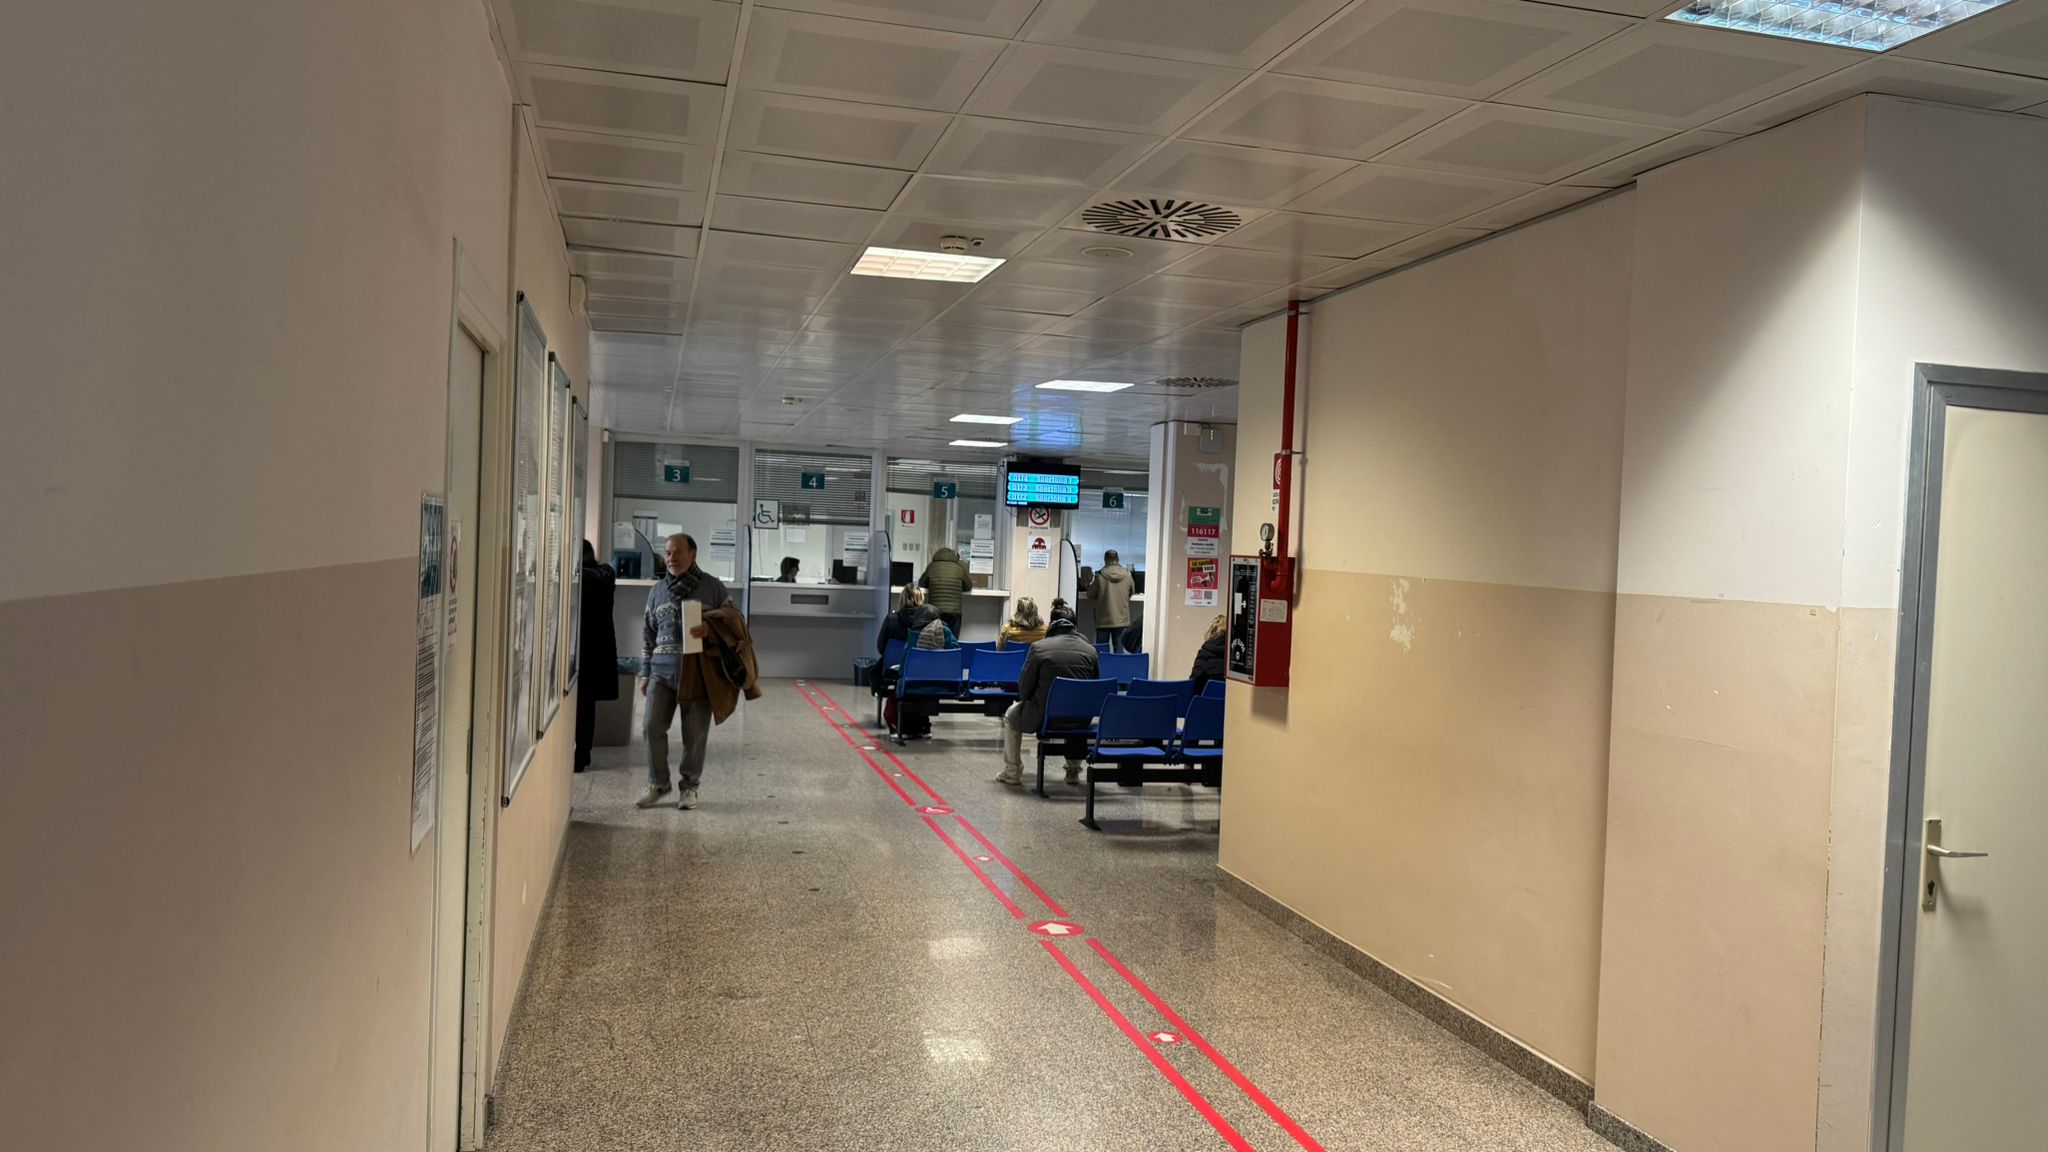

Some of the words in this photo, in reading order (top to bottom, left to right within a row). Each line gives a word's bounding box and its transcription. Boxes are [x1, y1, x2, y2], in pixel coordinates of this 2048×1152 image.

[672, 469, 681, 481] 3
[808, 476, 818, 488] 4
[941, 486, 949, 498] 5
[1110, 496, 1117, 507] 6
[1191, 527, 1216, 535] 116117
